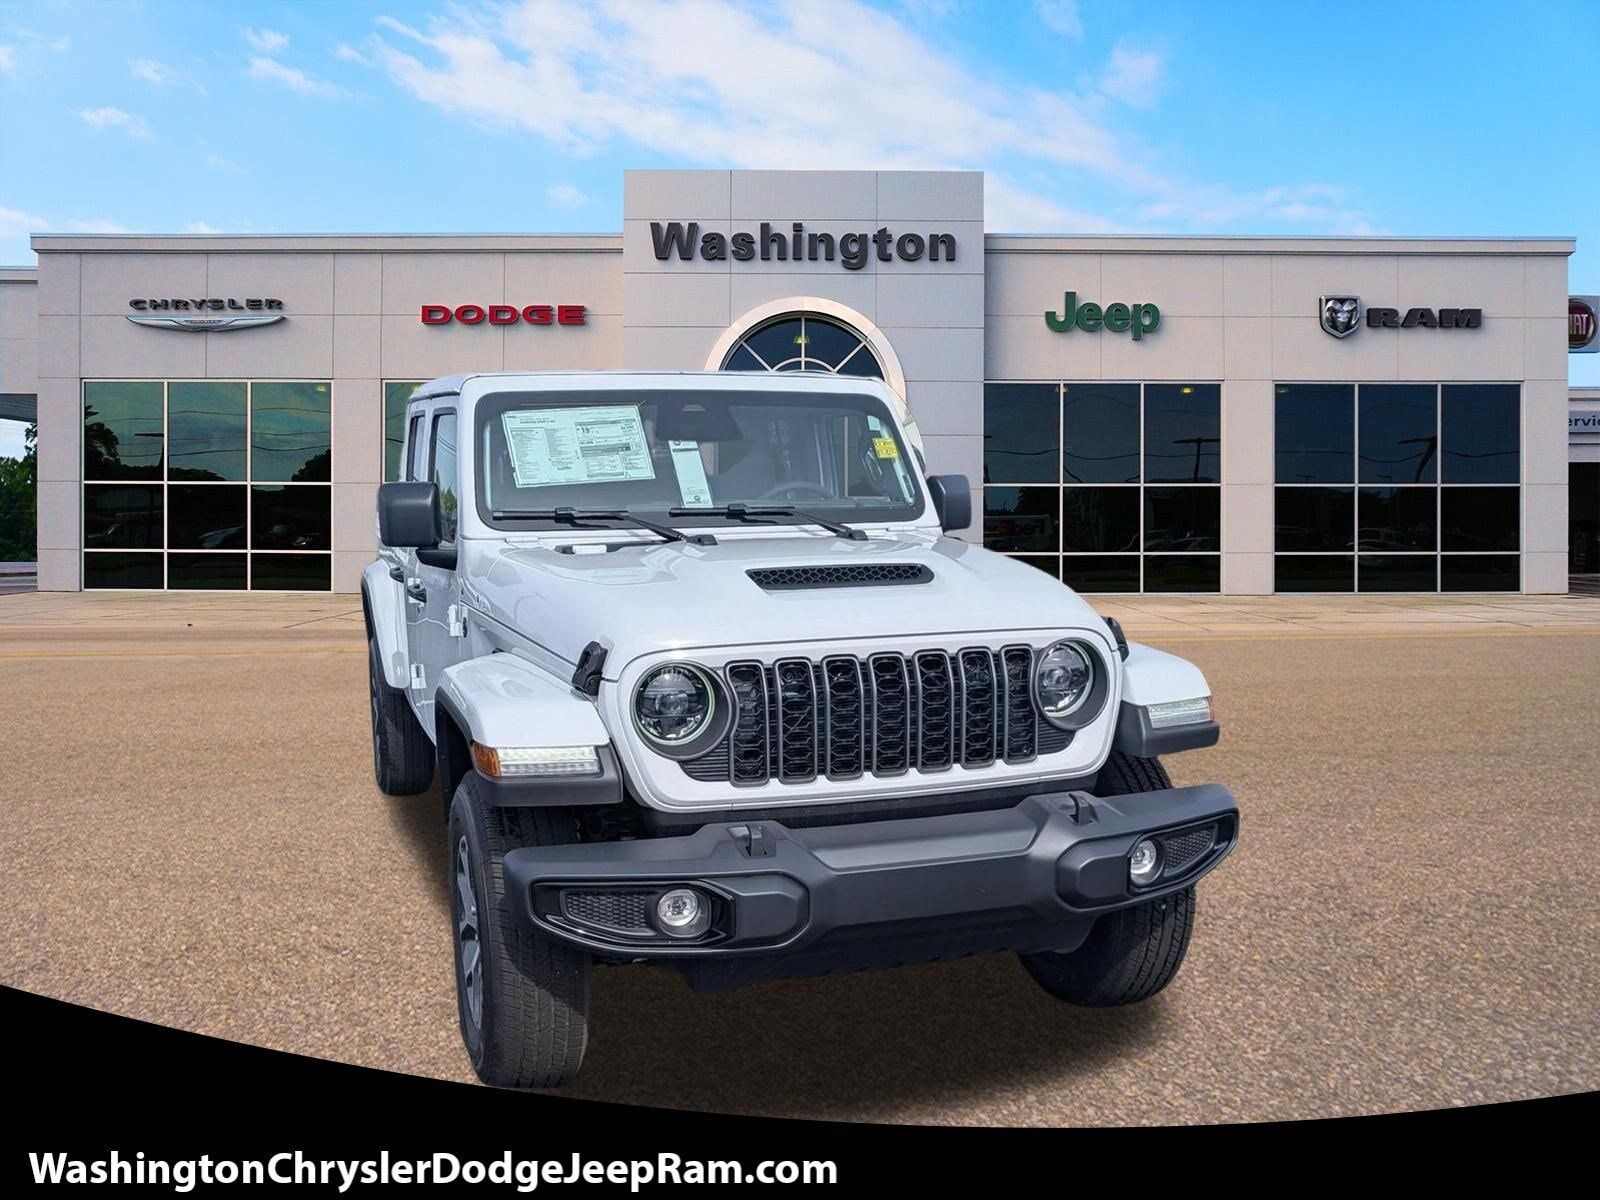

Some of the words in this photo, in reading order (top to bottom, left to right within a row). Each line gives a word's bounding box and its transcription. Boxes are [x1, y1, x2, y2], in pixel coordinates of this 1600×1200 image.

[649, 221, 957, 271] Washington
[128, 298, 285, 311] CHRYSLER
[421, 305, 586, 325] DODGE
[1045, 291, 1161, 341] Jeep
[1366, 308, 1482, 329] RAM
[1568, 314, 1589, 335] IAT
[1568, 415, 1600, 426] ervi
